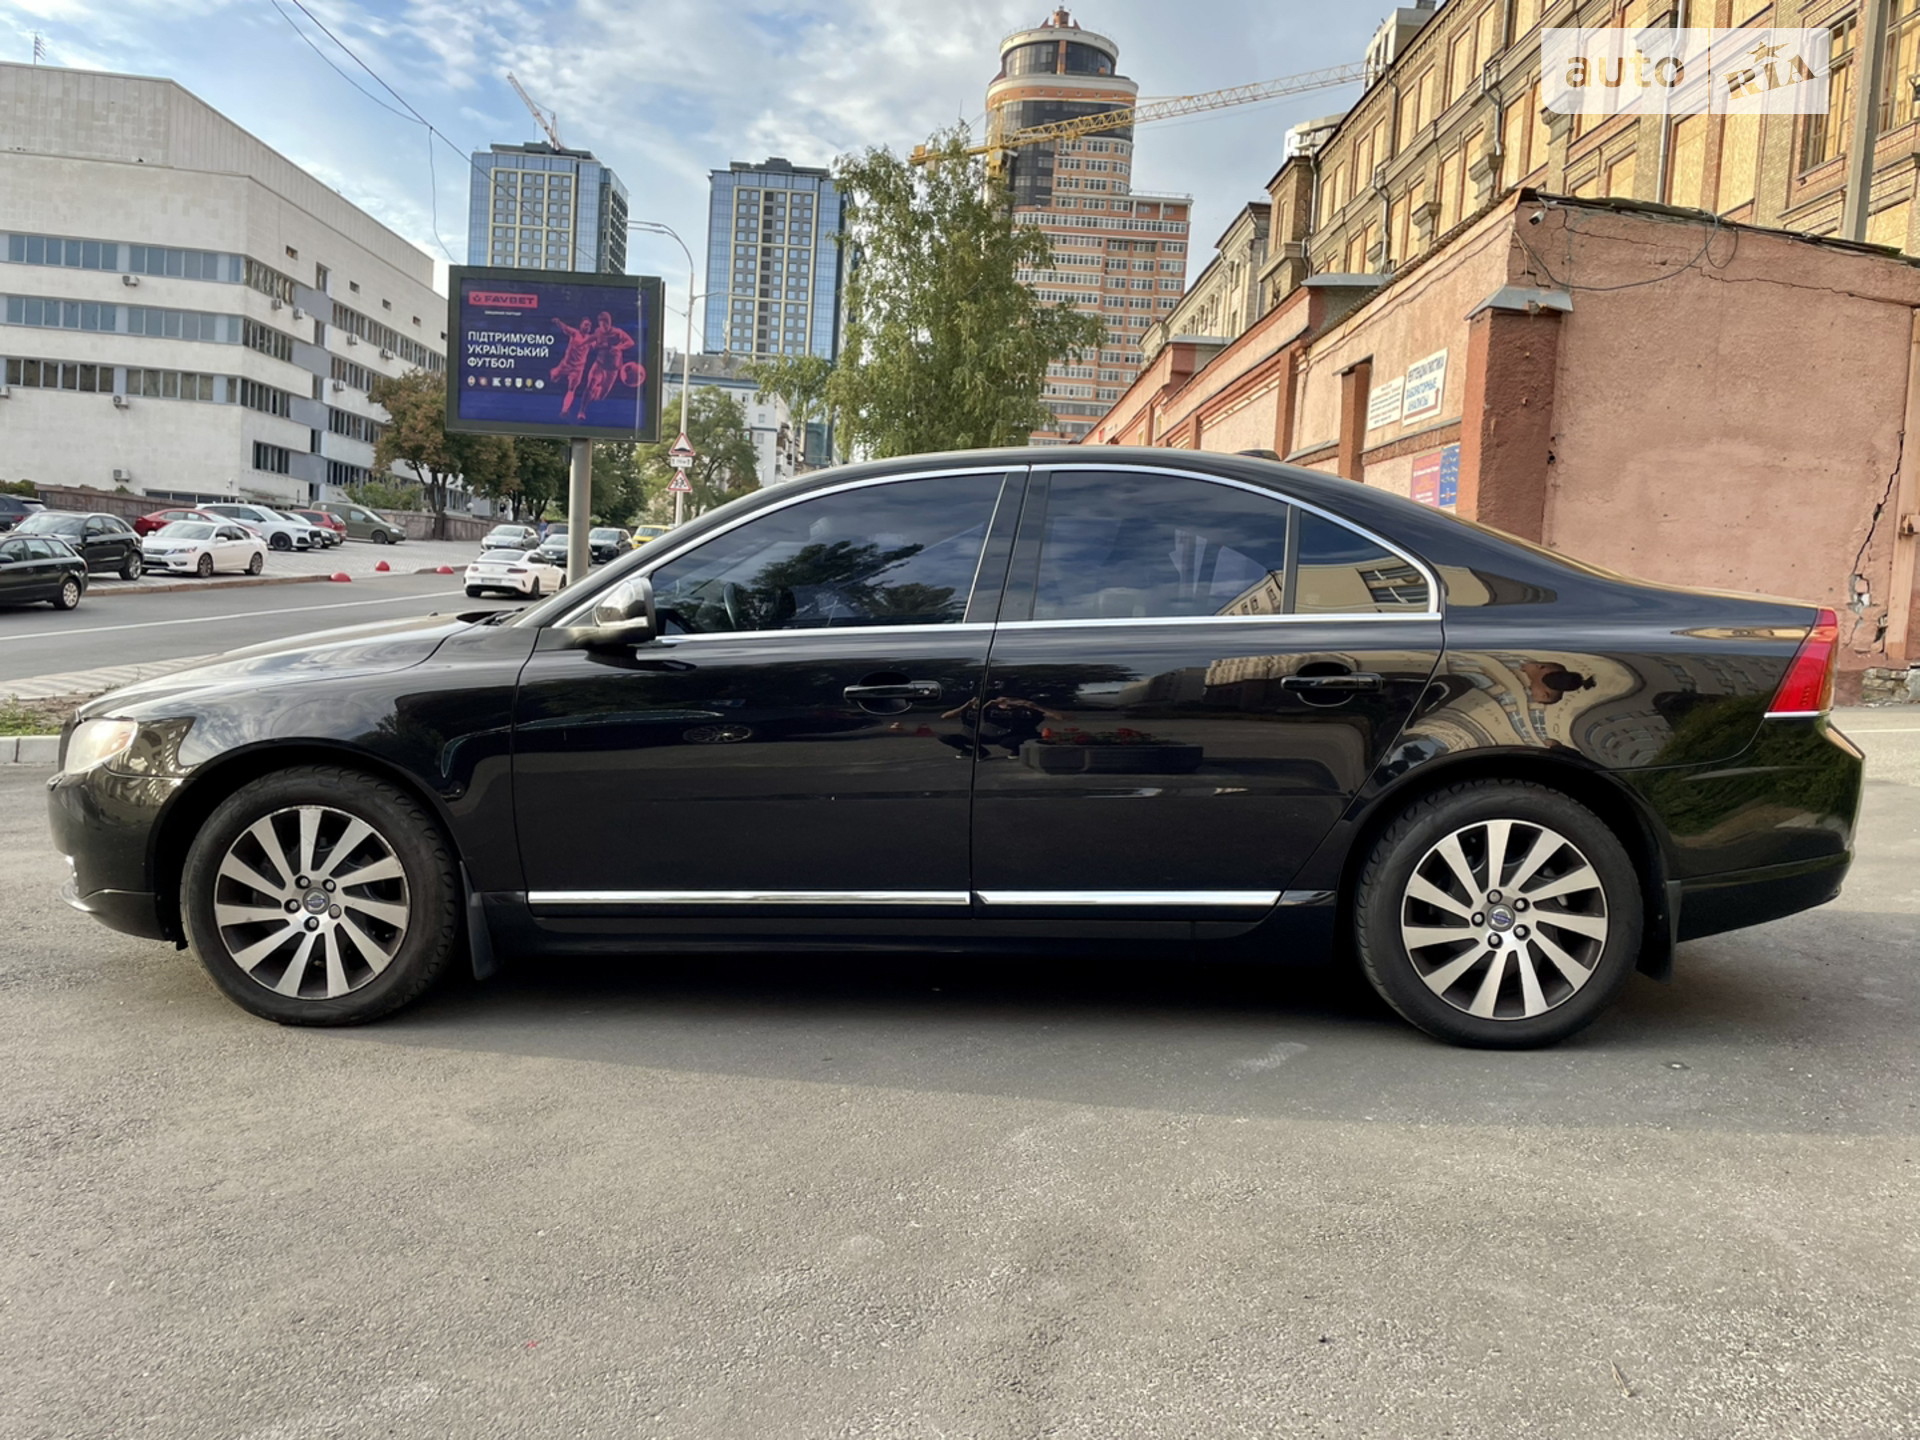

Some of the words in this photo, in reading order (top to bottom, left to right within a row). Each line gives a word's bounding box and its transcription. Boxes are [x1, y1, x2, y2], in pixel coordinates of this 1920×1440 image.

[485, 295, 534, 305] FAVBET
[468, 331, 554, 345] ПІДТРИМУЄМО
[467, 344, 549, 357] УКРАЇНСЬКИЙ
[467, 357, 515, 368] ФУТБОЛ
